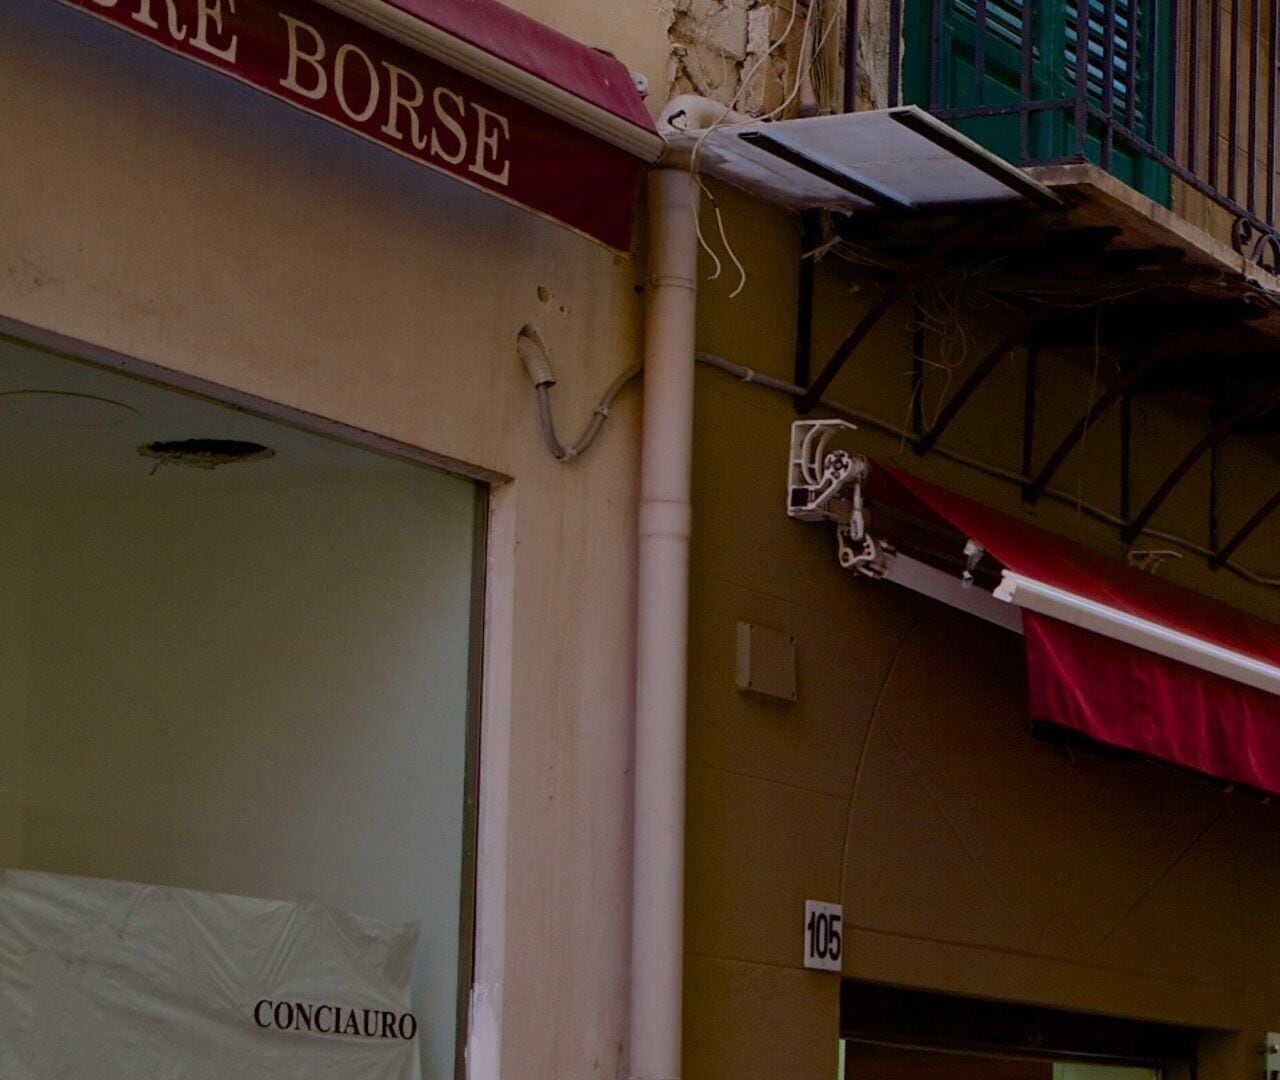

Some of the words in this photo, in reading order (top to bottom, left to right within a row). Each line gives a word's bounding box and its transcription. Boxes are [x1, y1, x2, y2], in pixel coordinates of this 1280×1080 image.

[93, 0, 238, 64] RE
[279, 12, 511, 186] BORSE
[808, 911, 841, 961] 105
[254, 999, 417, 1041] CONCIAURO
